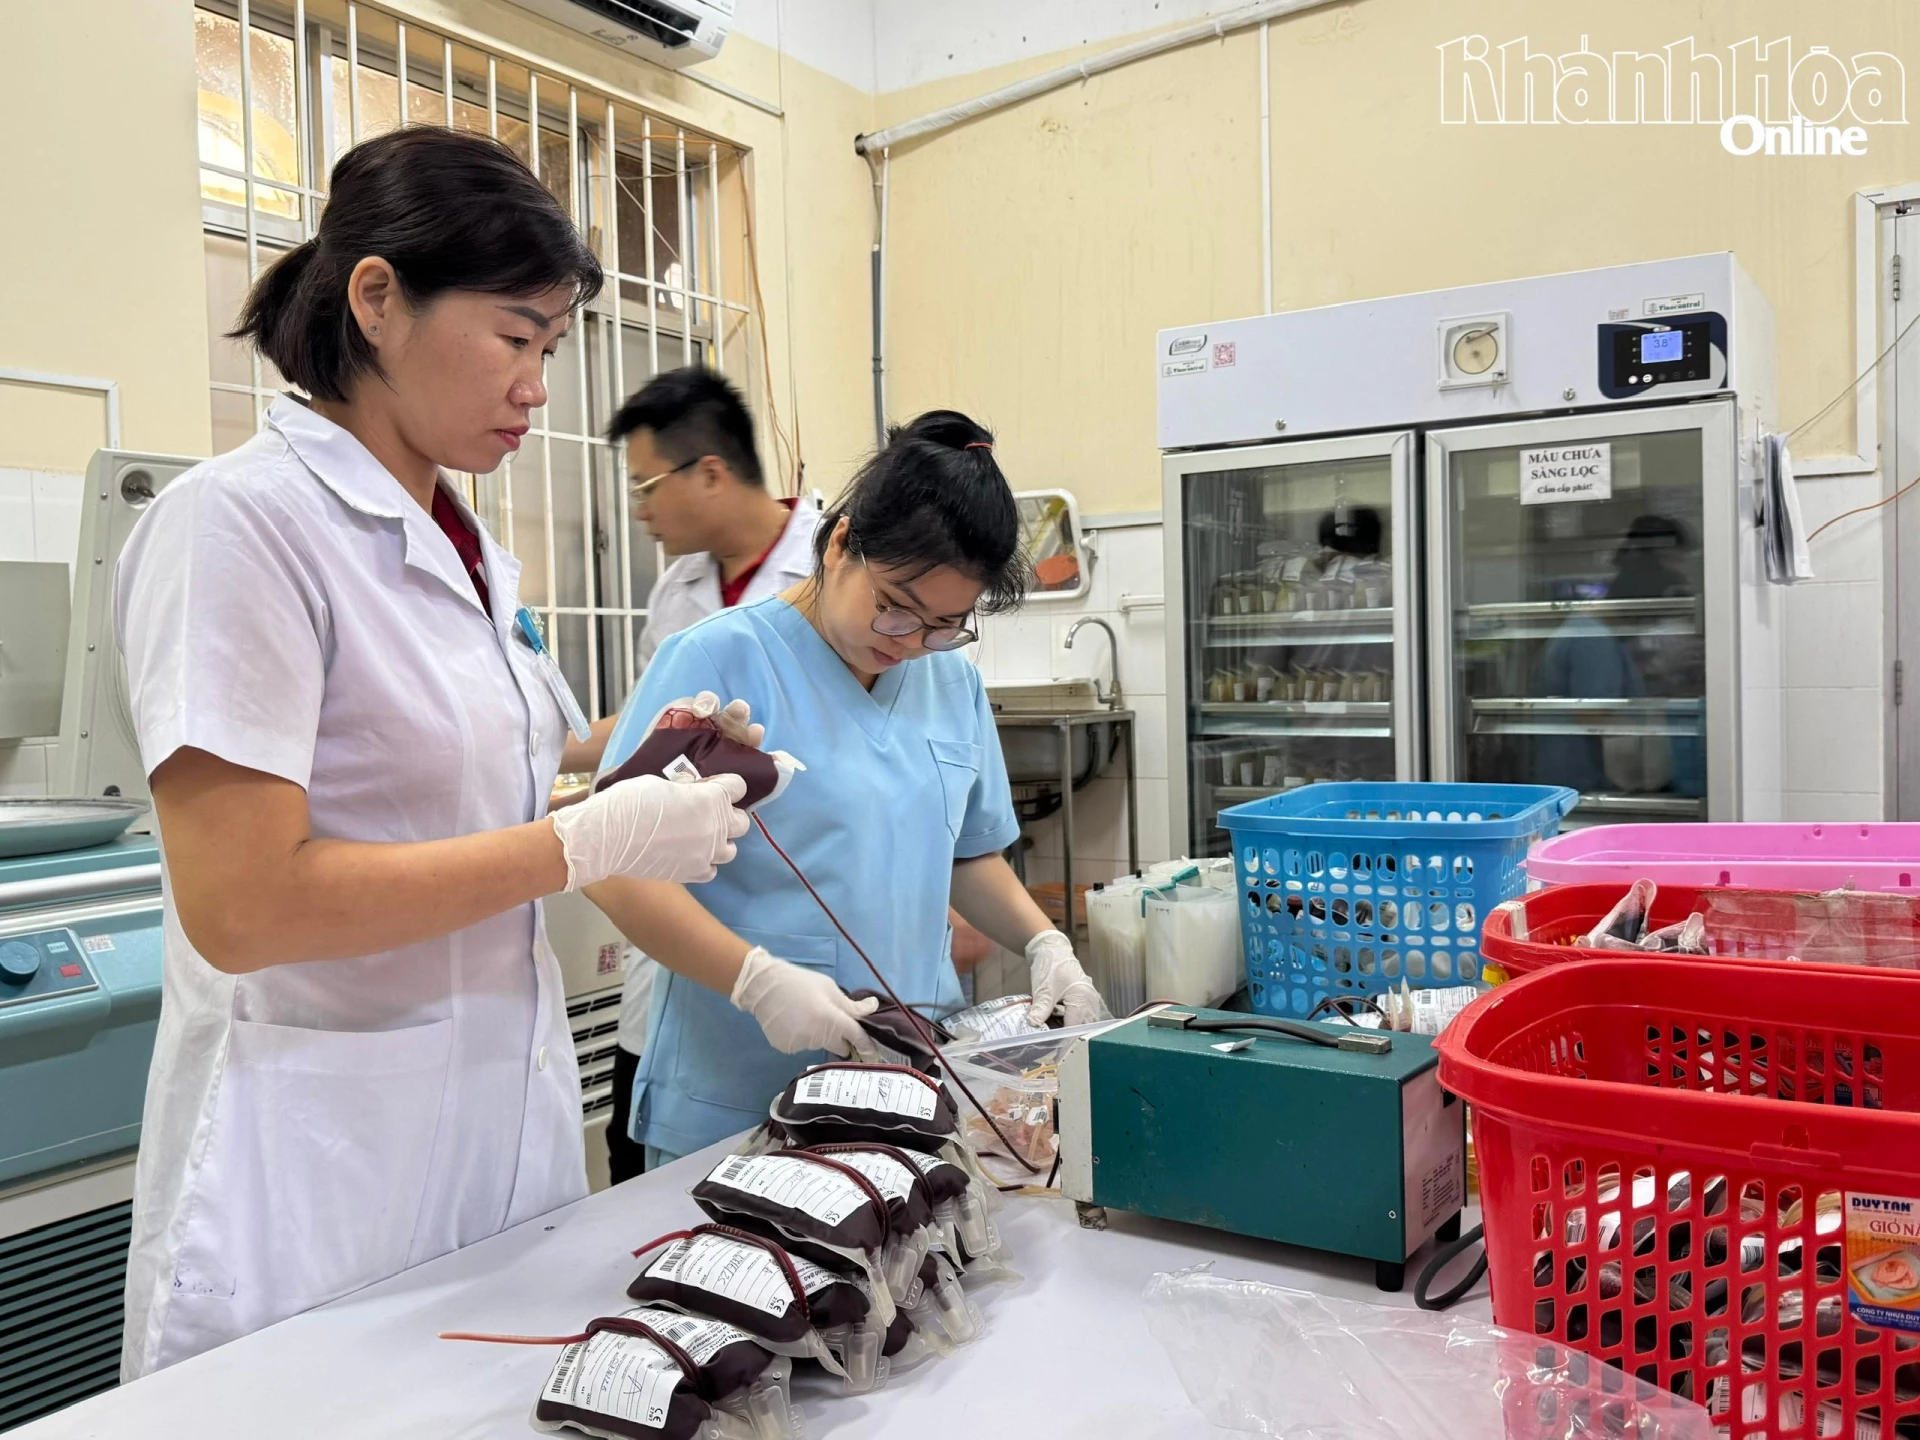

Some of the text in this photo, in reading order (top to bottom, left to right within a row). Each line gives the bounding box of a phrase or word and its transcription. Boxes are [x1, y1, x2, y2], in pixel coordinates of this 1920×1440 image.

[1528, 447, 1602, 464] MÁU CHƯA
[1571, 465, 1599, 478] LỌC
[1852, 1197, 1911, 1212] DUYTAN
[1869, 1218, 1901, 1235] GIỎ
